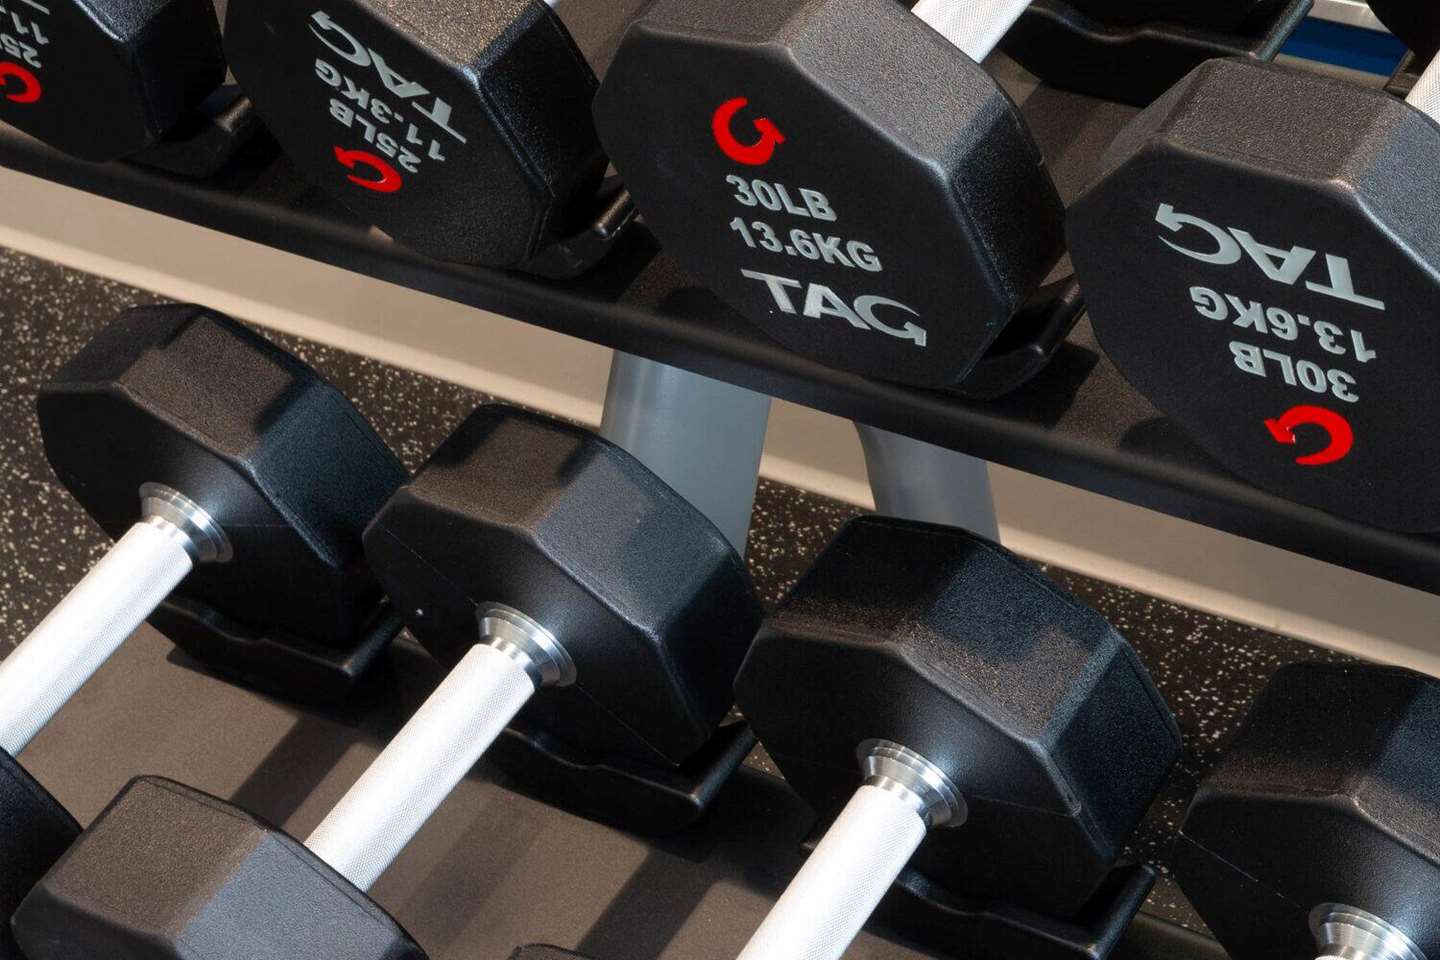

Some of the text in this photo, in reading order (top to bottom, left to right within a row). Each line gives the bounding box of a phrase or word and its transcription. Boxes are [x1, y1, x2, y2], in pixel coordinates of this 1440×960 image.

[308, 10, 467, 144] TAG
[315, 58, 446, 162] 11.3KG
[329, 98, 422, 173] 25LB
[725, 174, 837, 222] 30LB
[729, 217, 883, 273] 13.6KG
[1155, 203, 1386, 311] TAG
[740, 268, 927, 347] TAG
[1188, 286, 1377, 363] 13.6KG
[1228, 340, 1360, 403] 30LB
